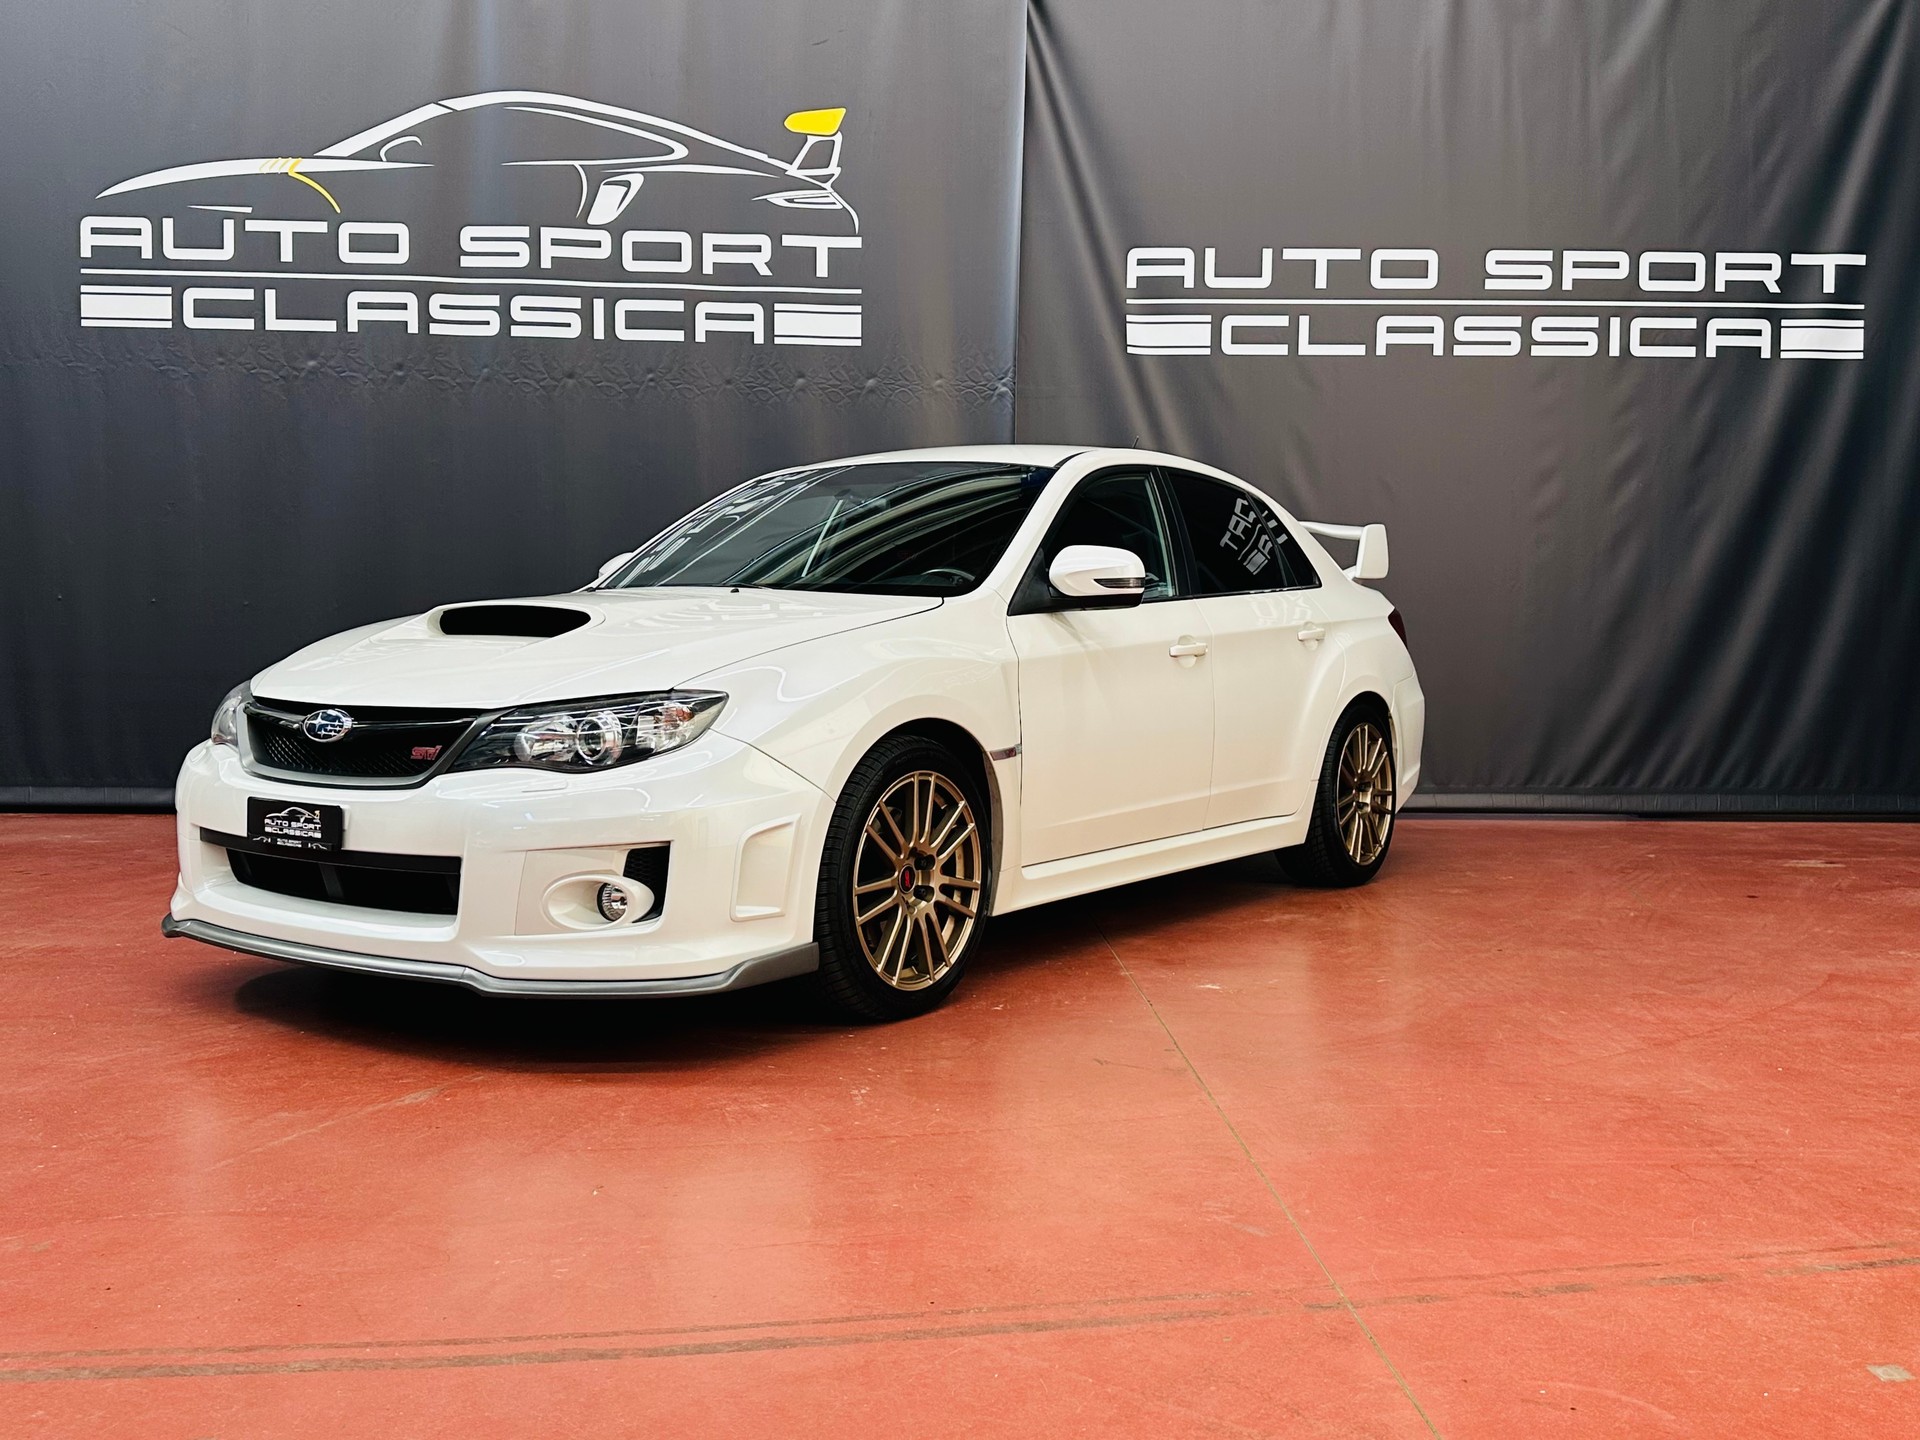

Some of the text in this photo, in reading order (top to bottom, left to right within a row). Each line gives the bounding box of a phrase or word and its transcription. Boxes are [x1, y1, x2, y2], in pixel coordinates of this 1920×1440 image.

[80, 216, 863, 278] AUTO SPORT
[1126, 246, 1867, 294] AUTO SPORT
[182, 287, 765, 344] CLASSICA
[1221, 314, 1772, 359] CLASSICA
[264, 818, 321, 830] AUTO SPORT
[271, 827, 314, 837] CLASSICA
